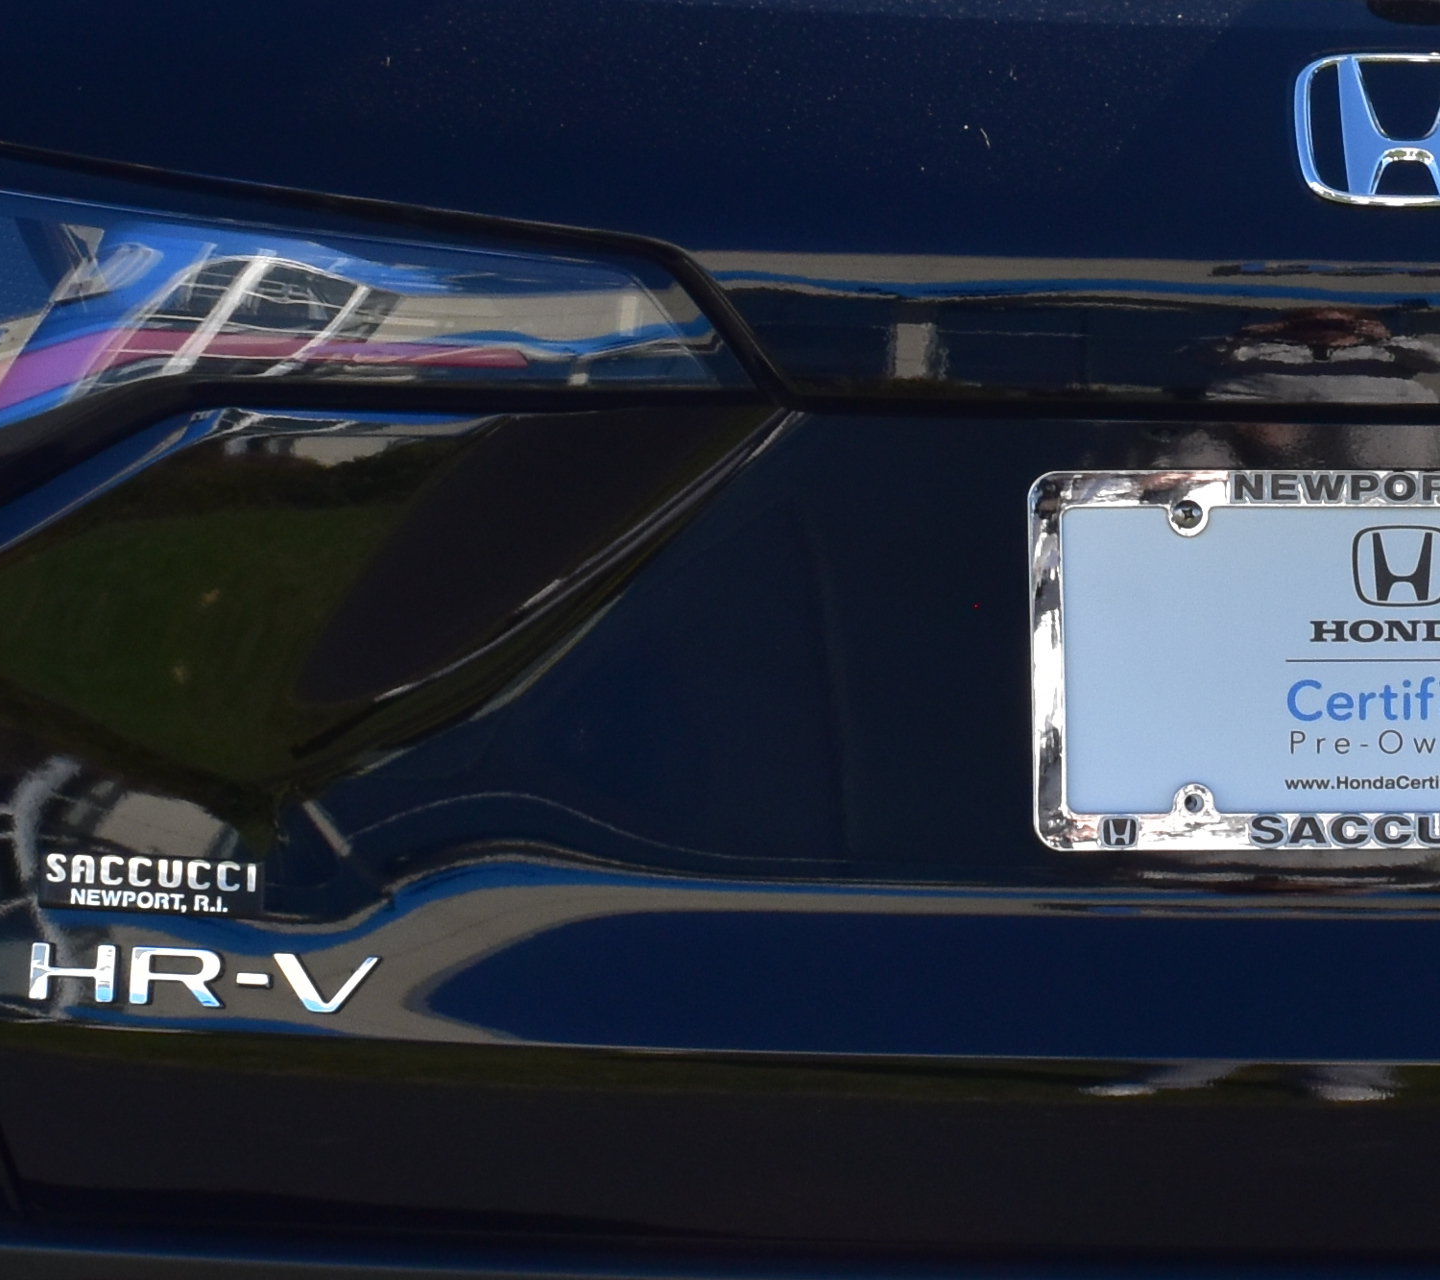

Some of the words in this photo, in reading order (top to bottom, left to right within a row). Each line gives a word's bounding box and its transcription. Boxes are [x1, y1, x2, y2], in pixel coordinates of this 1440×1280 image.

[45, 852, 258, 894] SACCUCCI
[70, 888, 188, 913] NEWPORT,
[193, 893, 229, 914] R.I.
[28, 941, 383, 1014] HR-V
